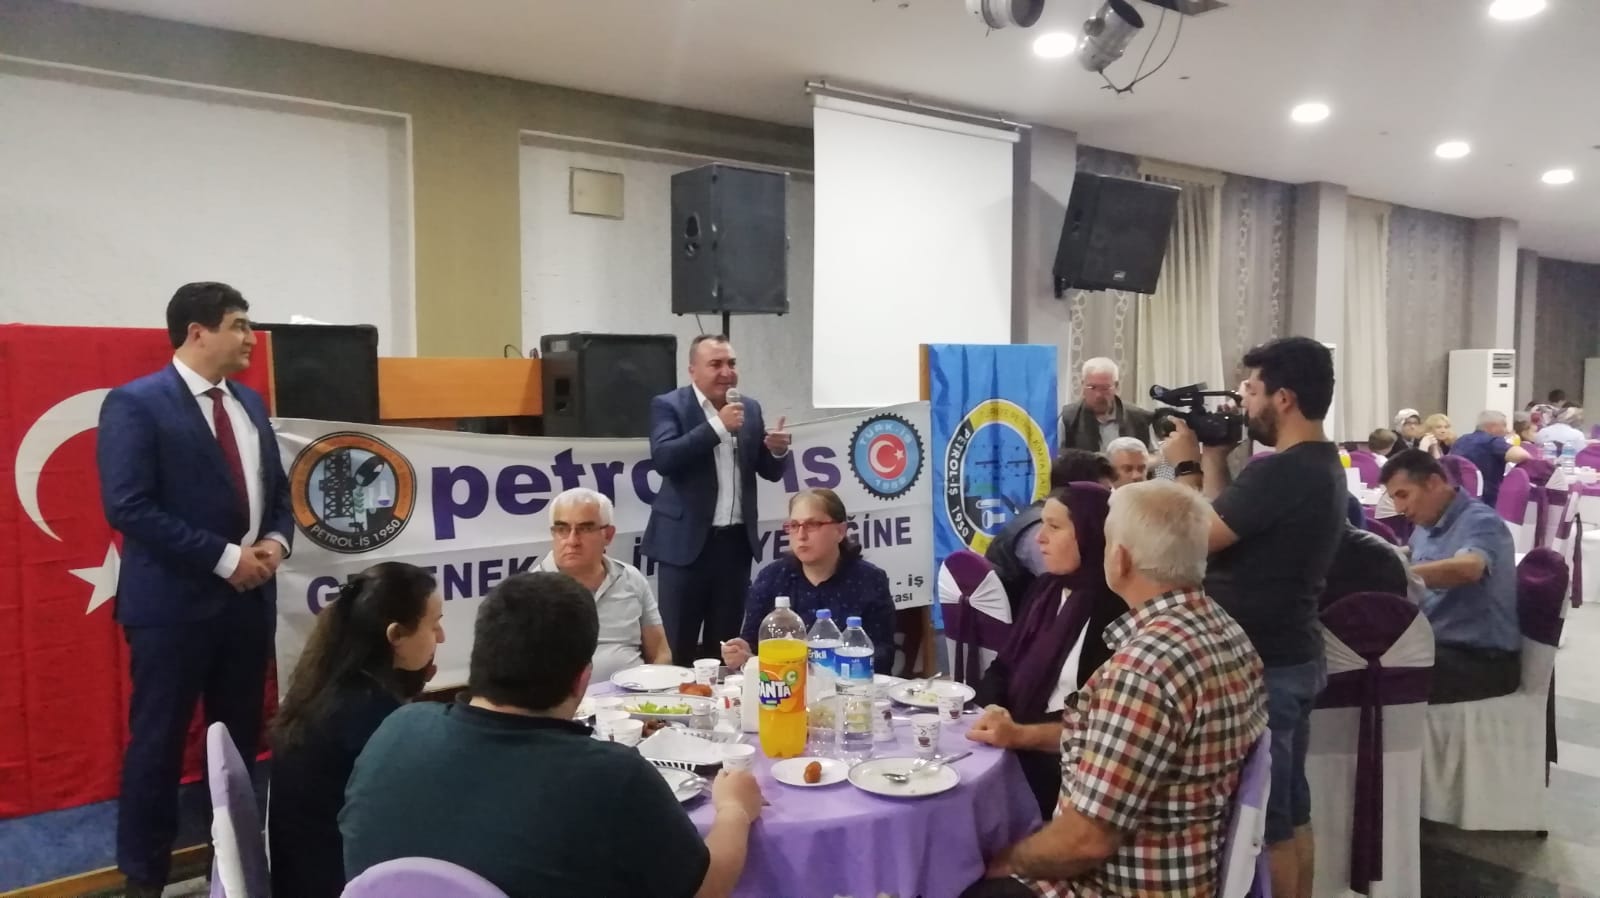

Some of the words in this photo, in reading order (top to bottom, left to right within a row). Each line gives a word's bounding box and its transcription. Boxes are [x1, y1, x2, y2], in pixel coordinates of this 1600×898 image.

[373, 519, 401, 541] 1950
[951, 506, 969, 537] 1950
[759, 680, 792, 699] ANTA
